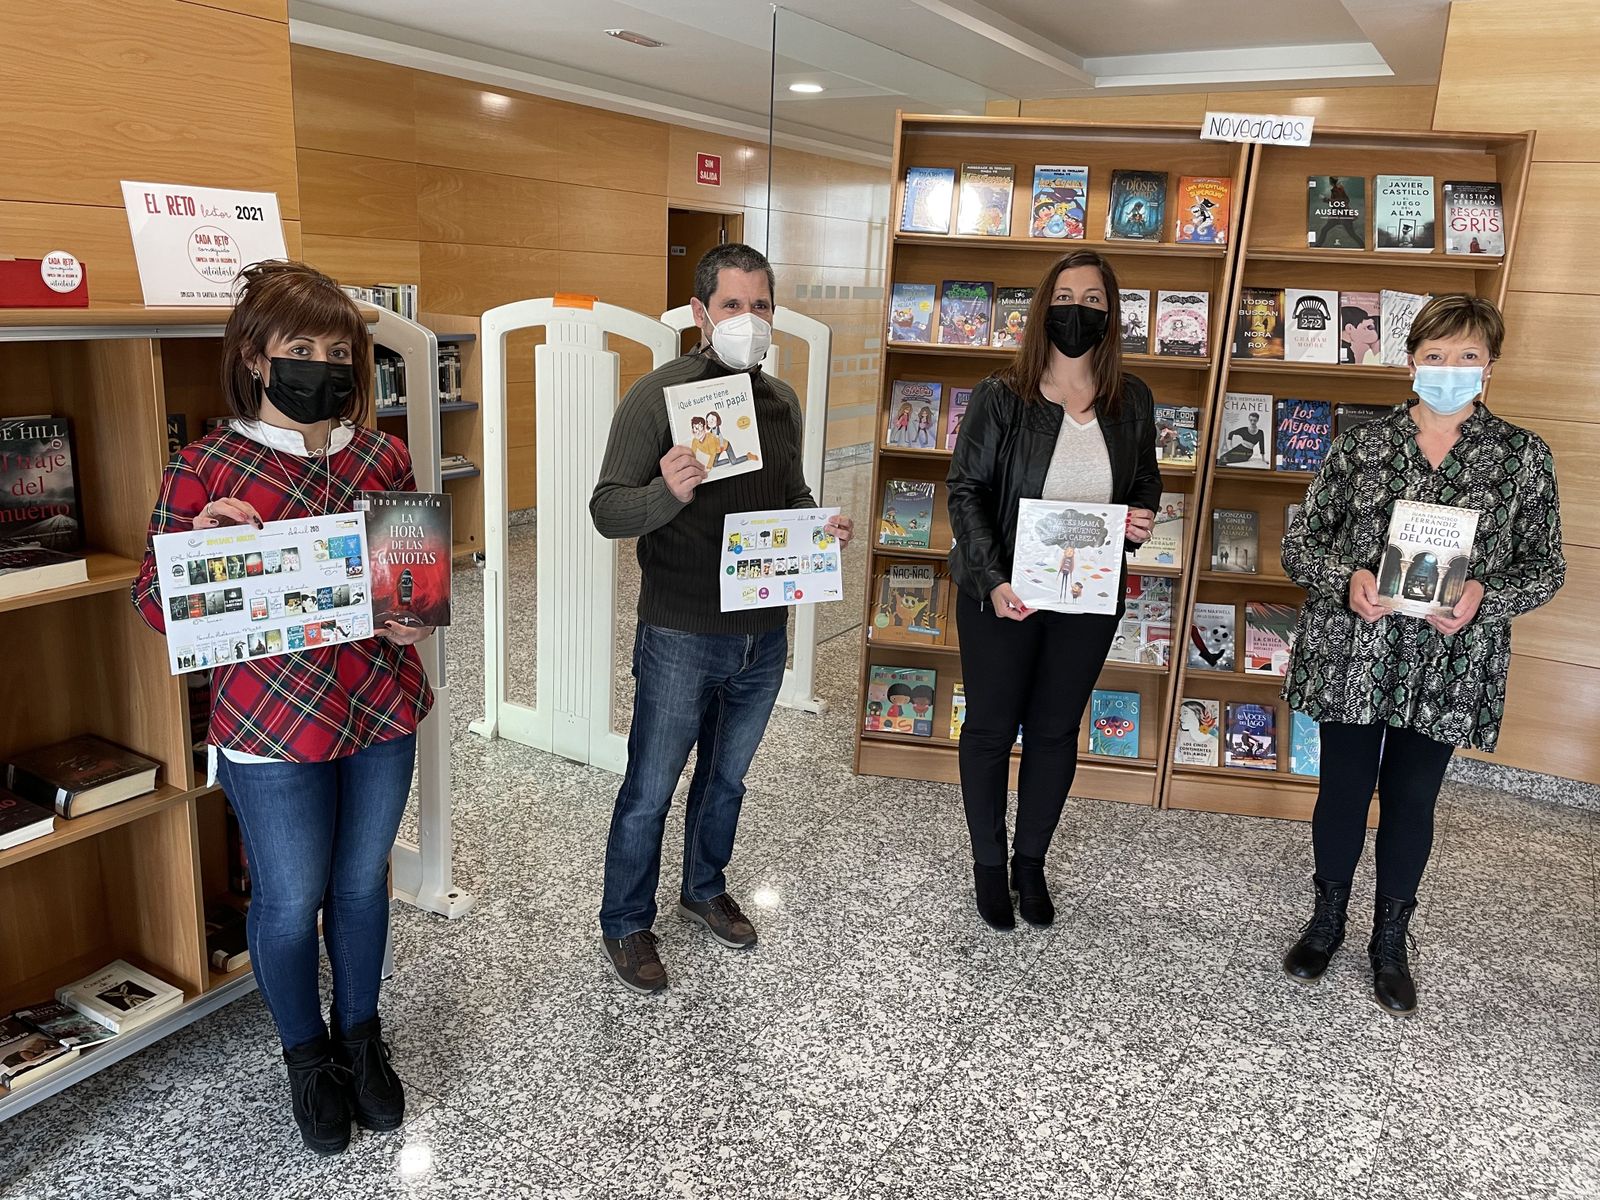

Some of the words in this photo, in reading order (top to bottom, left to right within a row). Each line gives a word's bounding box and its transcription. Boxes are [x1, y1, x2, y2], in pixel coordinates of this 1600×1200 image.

[704, 159, 714, 169] SIN
[700, 170, 718, 181] SALIDA
[1122, 179, 1158, 192] DIOSES
[144, 193, 161, 214] EL
[165, 195, 196, 217] RETO
[235, 205, 264, 222] 2021
[1315, 208, 1360, 217] AUSENTES
[1450, 207, 1499, 217] RESCATE
[1451, 217, 1500, 233] GRIS
[195, 234, 212, 245] CADA
[214, 235, 229, 247] RETO
[1242, 298, 1275, 306] TODOS
[1238, 309, 1279, 317] BUSCAN
[1301, 318, 1322, 328] 272
[693, 394, 712, 406] suerte
[713, 389, 729, 399] tiene
[714, 399, 725, 410] mi
[726, 391, 748, 409] papá!
[1224, 400, 1270, 412] CHANEL
[1293, 406, 1315, 420] LOS
[19, 424, 65, 439] HILL
[1279, 418, 1330, 435] MEJORES
[1287, 435, 1322, 451] AÑOS
[12, 476, 45, 497] del
[373, 499, 398, 507] IBON
[401, 513, 413, 524] LA
[1220, 511, 1252, 519] GONZALO
[1078, 519, 1100, 528] MAMÁ
[389, 525, 425, 538] HORA
[1404, 523, 1417, 533] EL
[1420, 525, 1461, 539] JUICIO
[391, 540, 404, 550] DE
[406, 540, 423, 550] LAS
[1400, 532, 1423, 543] DEL
[1424, 537, 1460, 549] AGUA
[378, 551, 436, 565] GAVIOTAS
[1243, 711, 1267, 721] VOCES
[1246, 719, 1264, 728] LAGO
